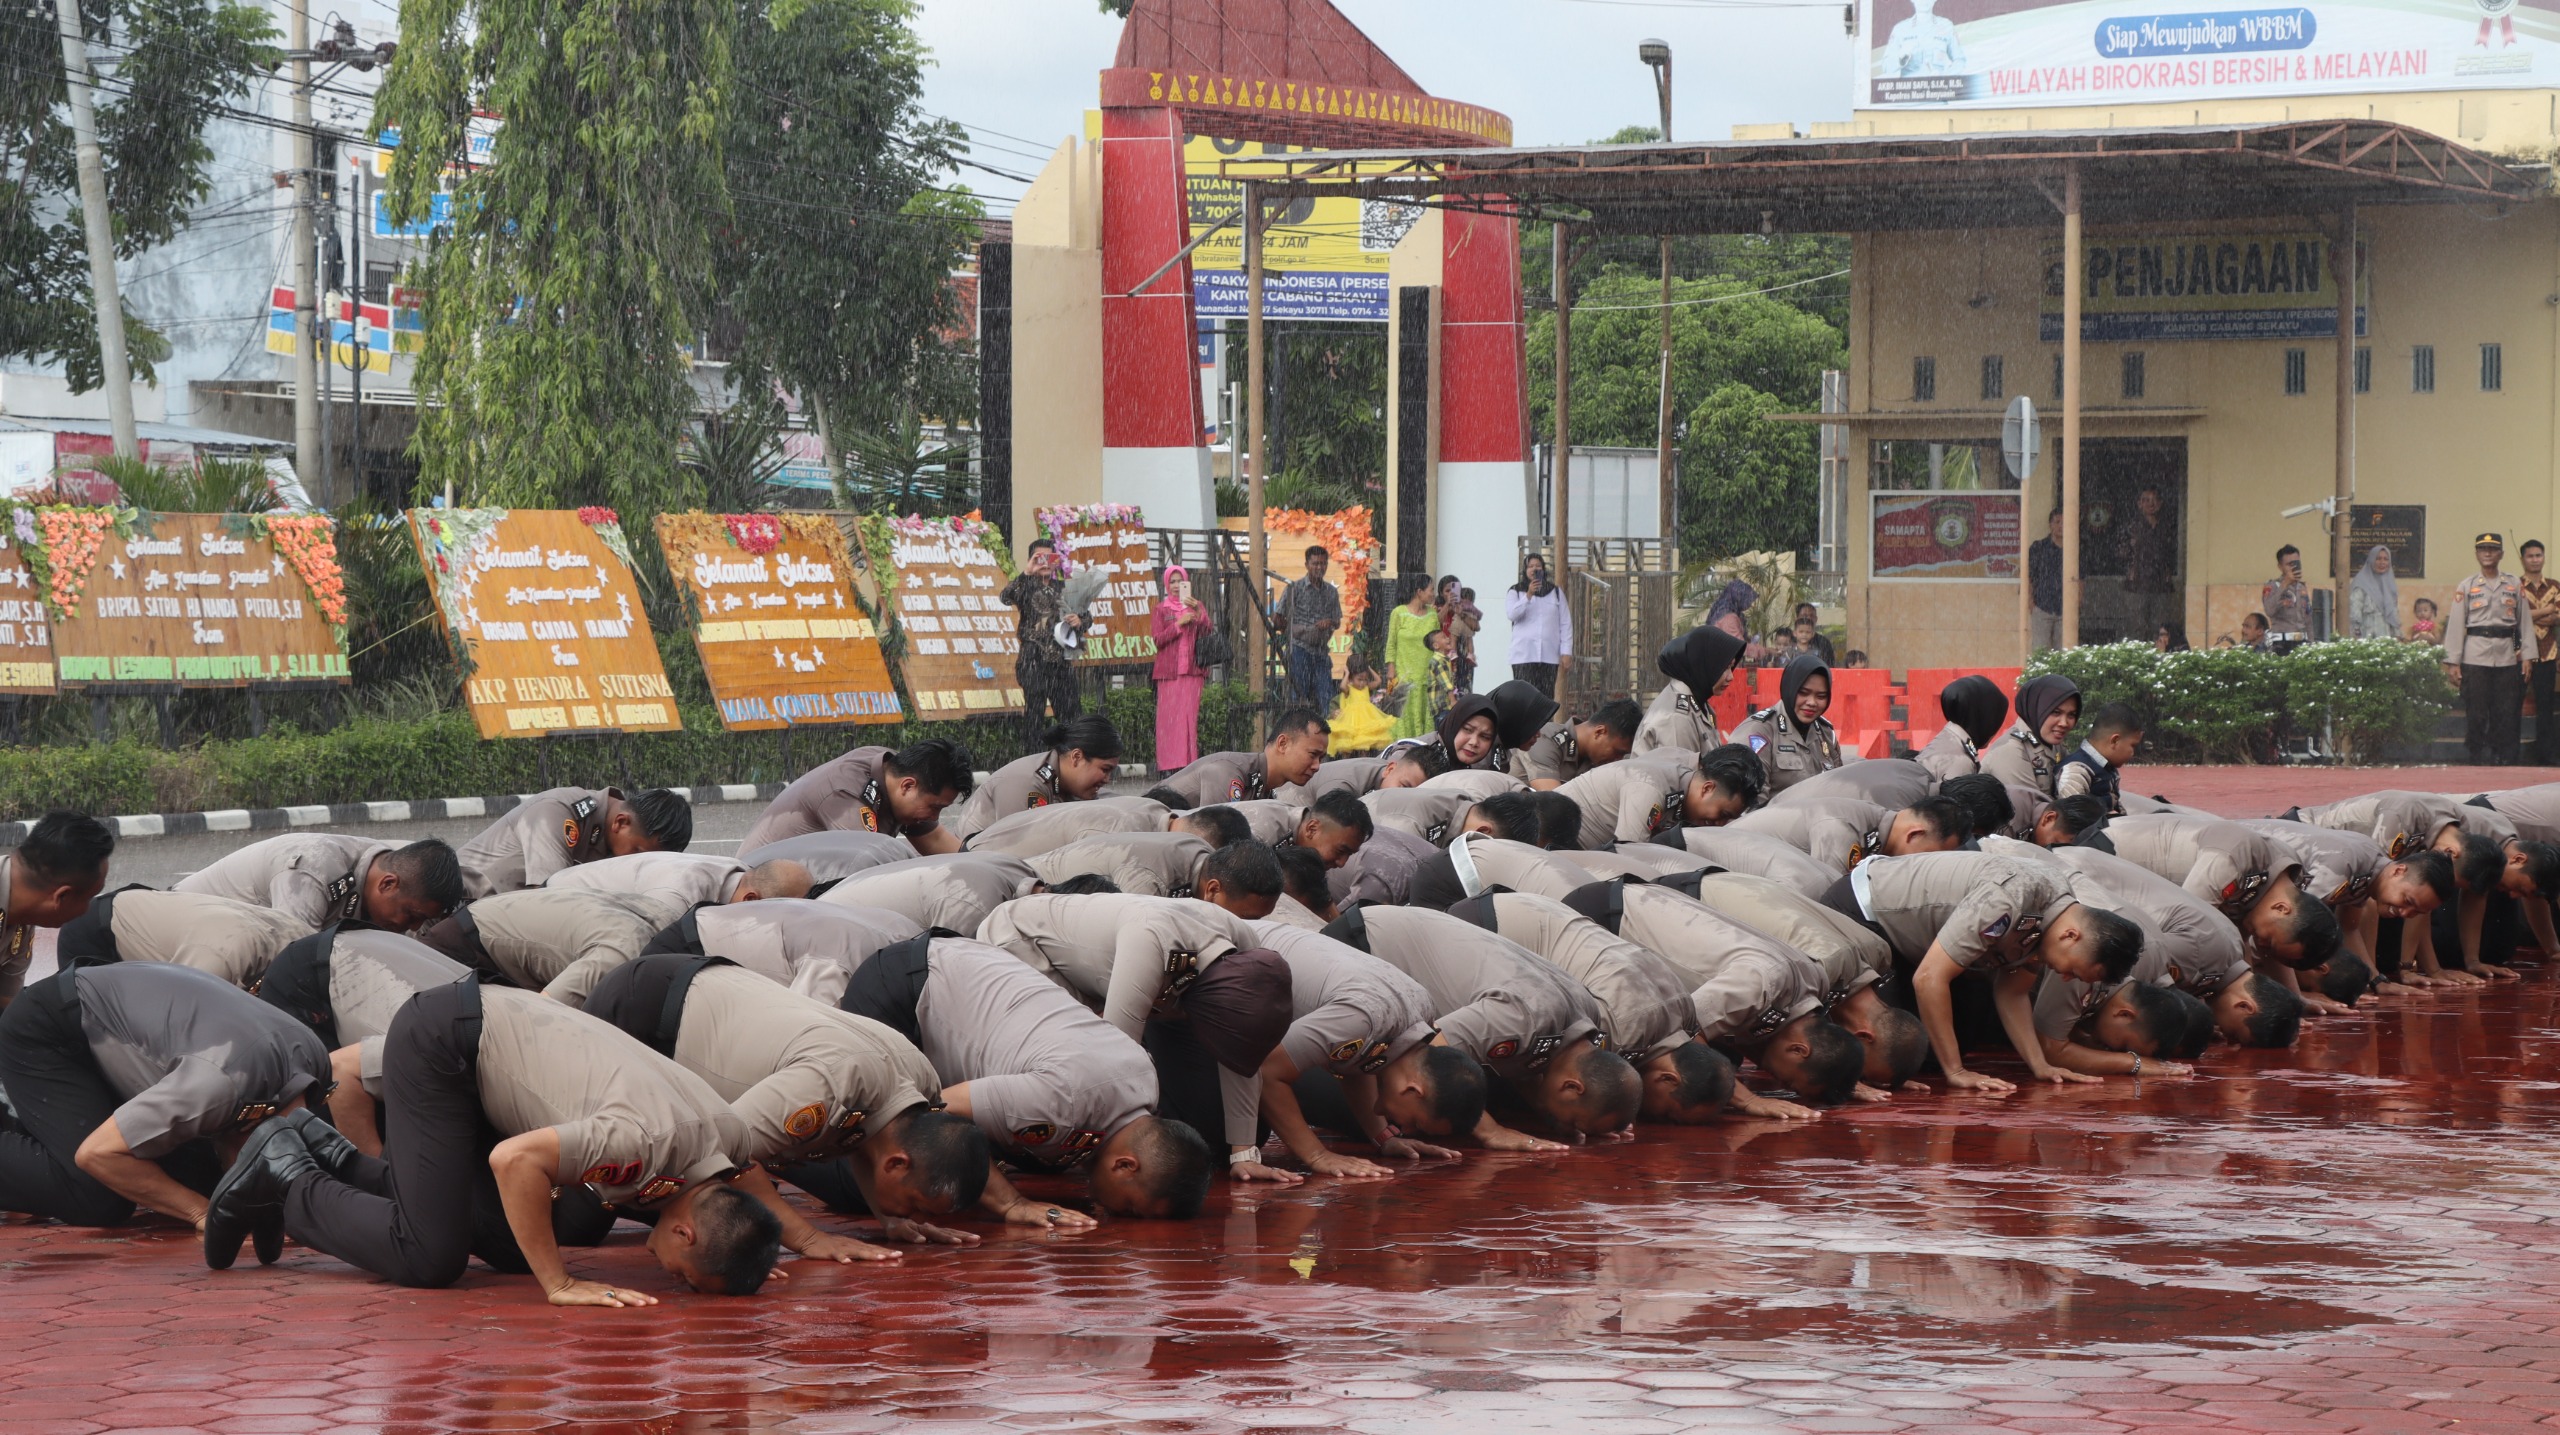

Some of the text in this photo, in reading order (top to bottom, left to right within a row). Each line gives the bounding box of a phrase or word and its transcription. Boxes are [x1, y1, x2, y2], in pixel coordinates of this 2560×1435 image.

[2106, 9, 2304, 56] Siap Mewujudkan WBBM
[1990, 49, 2428, 95] WILAYAH BIROKRASI BERSIH & MELAYANI
[1186, 178, 1232, 190] NTUAN
[1214, 236, 1243, 248] AND
[1279, 236, 1309, 248] JAM
[1364, 256, 1385, 264] Scan
[2088, 241, 2320, 298] PENJAGAAN
[1211, 276, 1250, 288] RAKYA
[1265, 276, 1338, 289] INDONESIA
[1341, 276, 1389, 290] (PERSE
[1268, 291, 1324, 303] CABANG
[1326, 292, 1378, 305] SEKAYU
[1272, 305, 1304, 315] Sekayu
[1305, 306, 1328, 314] 30711
[1329, 306, 1350, 316] Telp.
[1351, 307, 1372, 316] 0714
[2225, 310, 2284, 321] INDONESIA
[2287, 309, 2338, 319] (PERSERO
[2164, 320, 2300, 333] KANTOR CABANG SEKAYU
[1066, 530, 1113, 552] Selamat
[1884, 524, 1926, 536] SAMAPTA
[125, 532, 246, 560] Selamat Sukses
[890, 533, 997, 569] Selamat Sukses
[474, 544, 590, 572] Selamat Sukses
[694, 552, 835, 589] Selamat Sukses
[97, 596, 141, 619] BRIPKA
[144, 596, 182, 618] SATRIA
[193, 619, 225, 645] From
[480, 619, 629, 641] BRIGADIR CANDRA IRAWAN
[470, 673, 675, 705] AKP HENDRA SUTISNA
